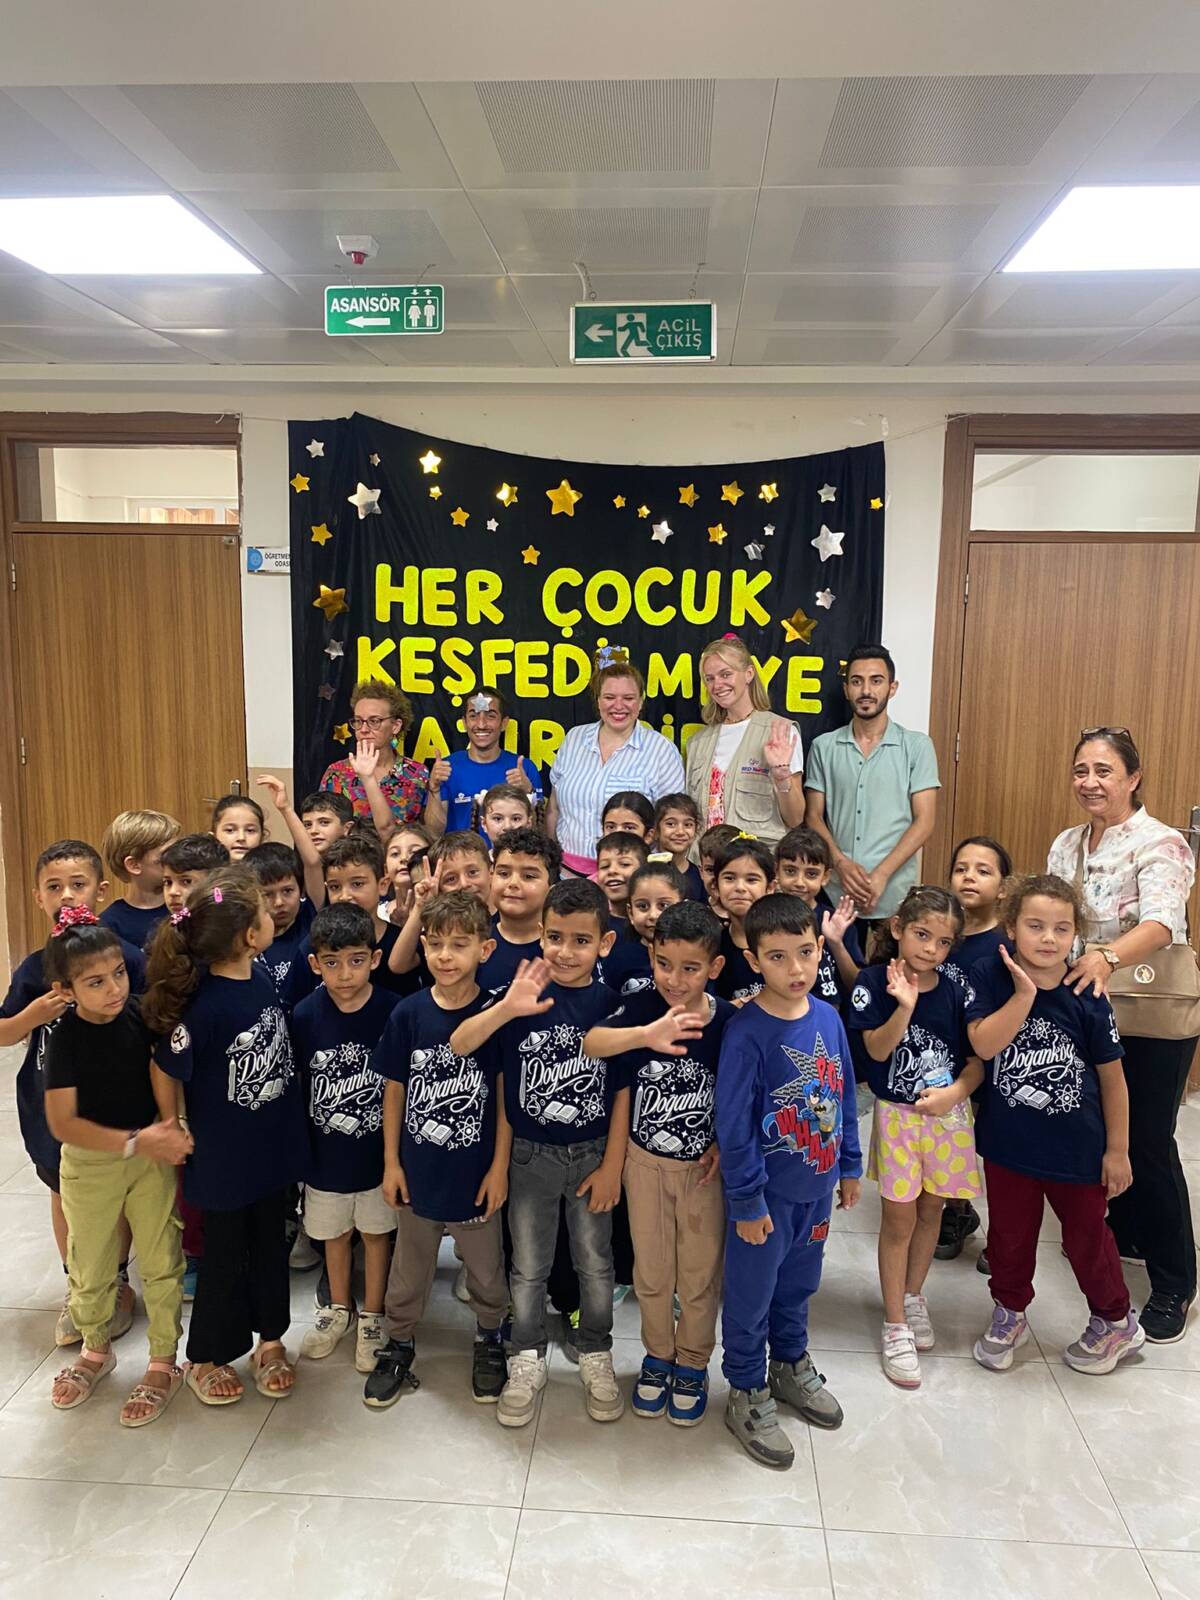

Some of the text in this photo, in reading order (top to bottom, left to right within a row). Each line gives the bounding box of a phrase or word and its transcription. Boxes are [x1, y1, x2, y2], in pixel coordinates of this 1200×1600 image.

[330, 293, 400, 313] ASANSÖR
[658, 319, 701, 332] ACİL
[656, 333, 702, 350] ÇIKIŞ
[375, 563, 772, 638] HER ÇOCUK
[818, 966, 832, 982] 19
[821, 981, 838, 996] 88
